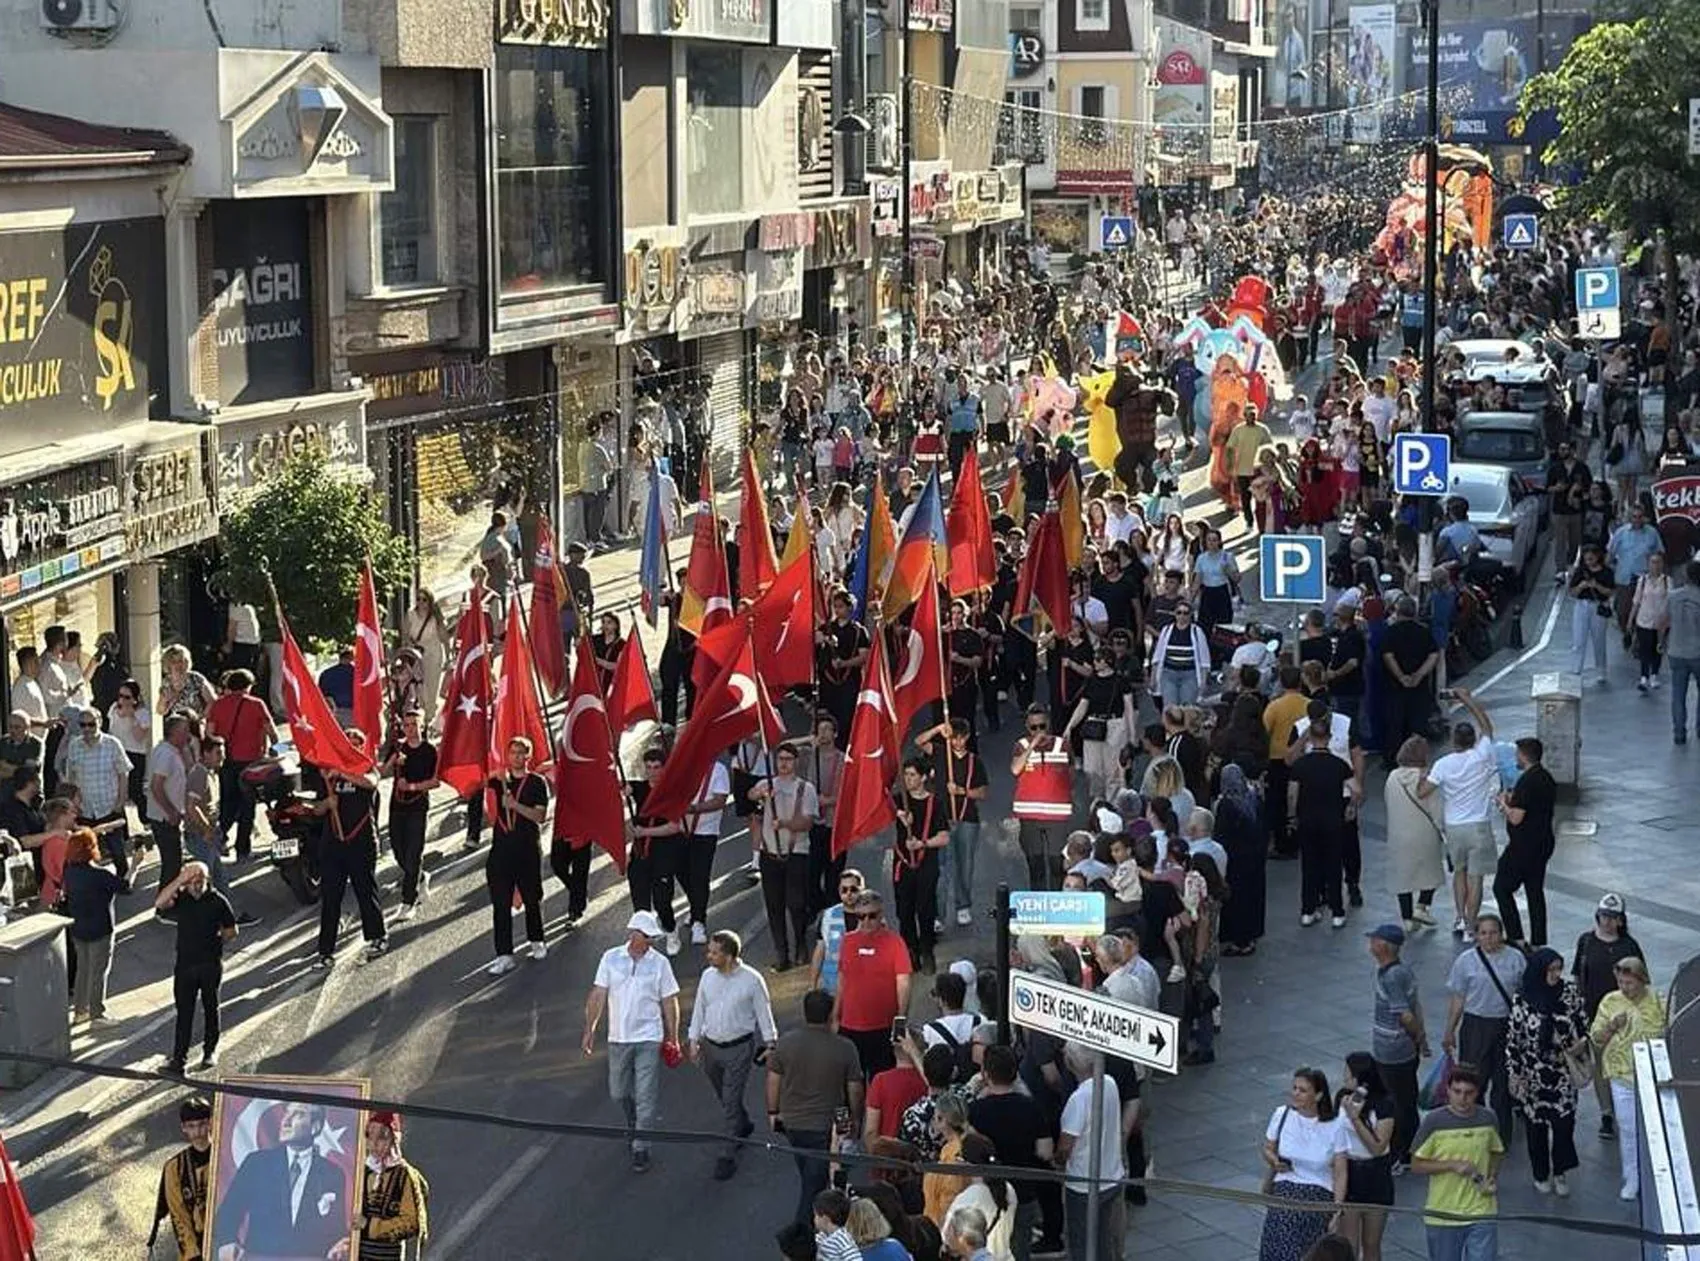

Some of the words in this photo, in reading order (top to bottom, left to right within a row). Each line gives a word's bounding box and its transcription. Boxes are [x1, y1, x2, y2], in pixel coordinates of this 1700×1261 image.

[1585, 273, 1609, 306] P
[217, 318, 302, 347] UYUMCULUK
[0, 359, 62, 405] CULUK
[1401, 440, 1431, 486] P
[1275, 543, 1311, 596] P
[1036, 991, 1057, 1018] TEK
[1059, 1000, 1089, 1029] GENÇ
[1090, 1008, 1141, 1043] AKADEMİ
